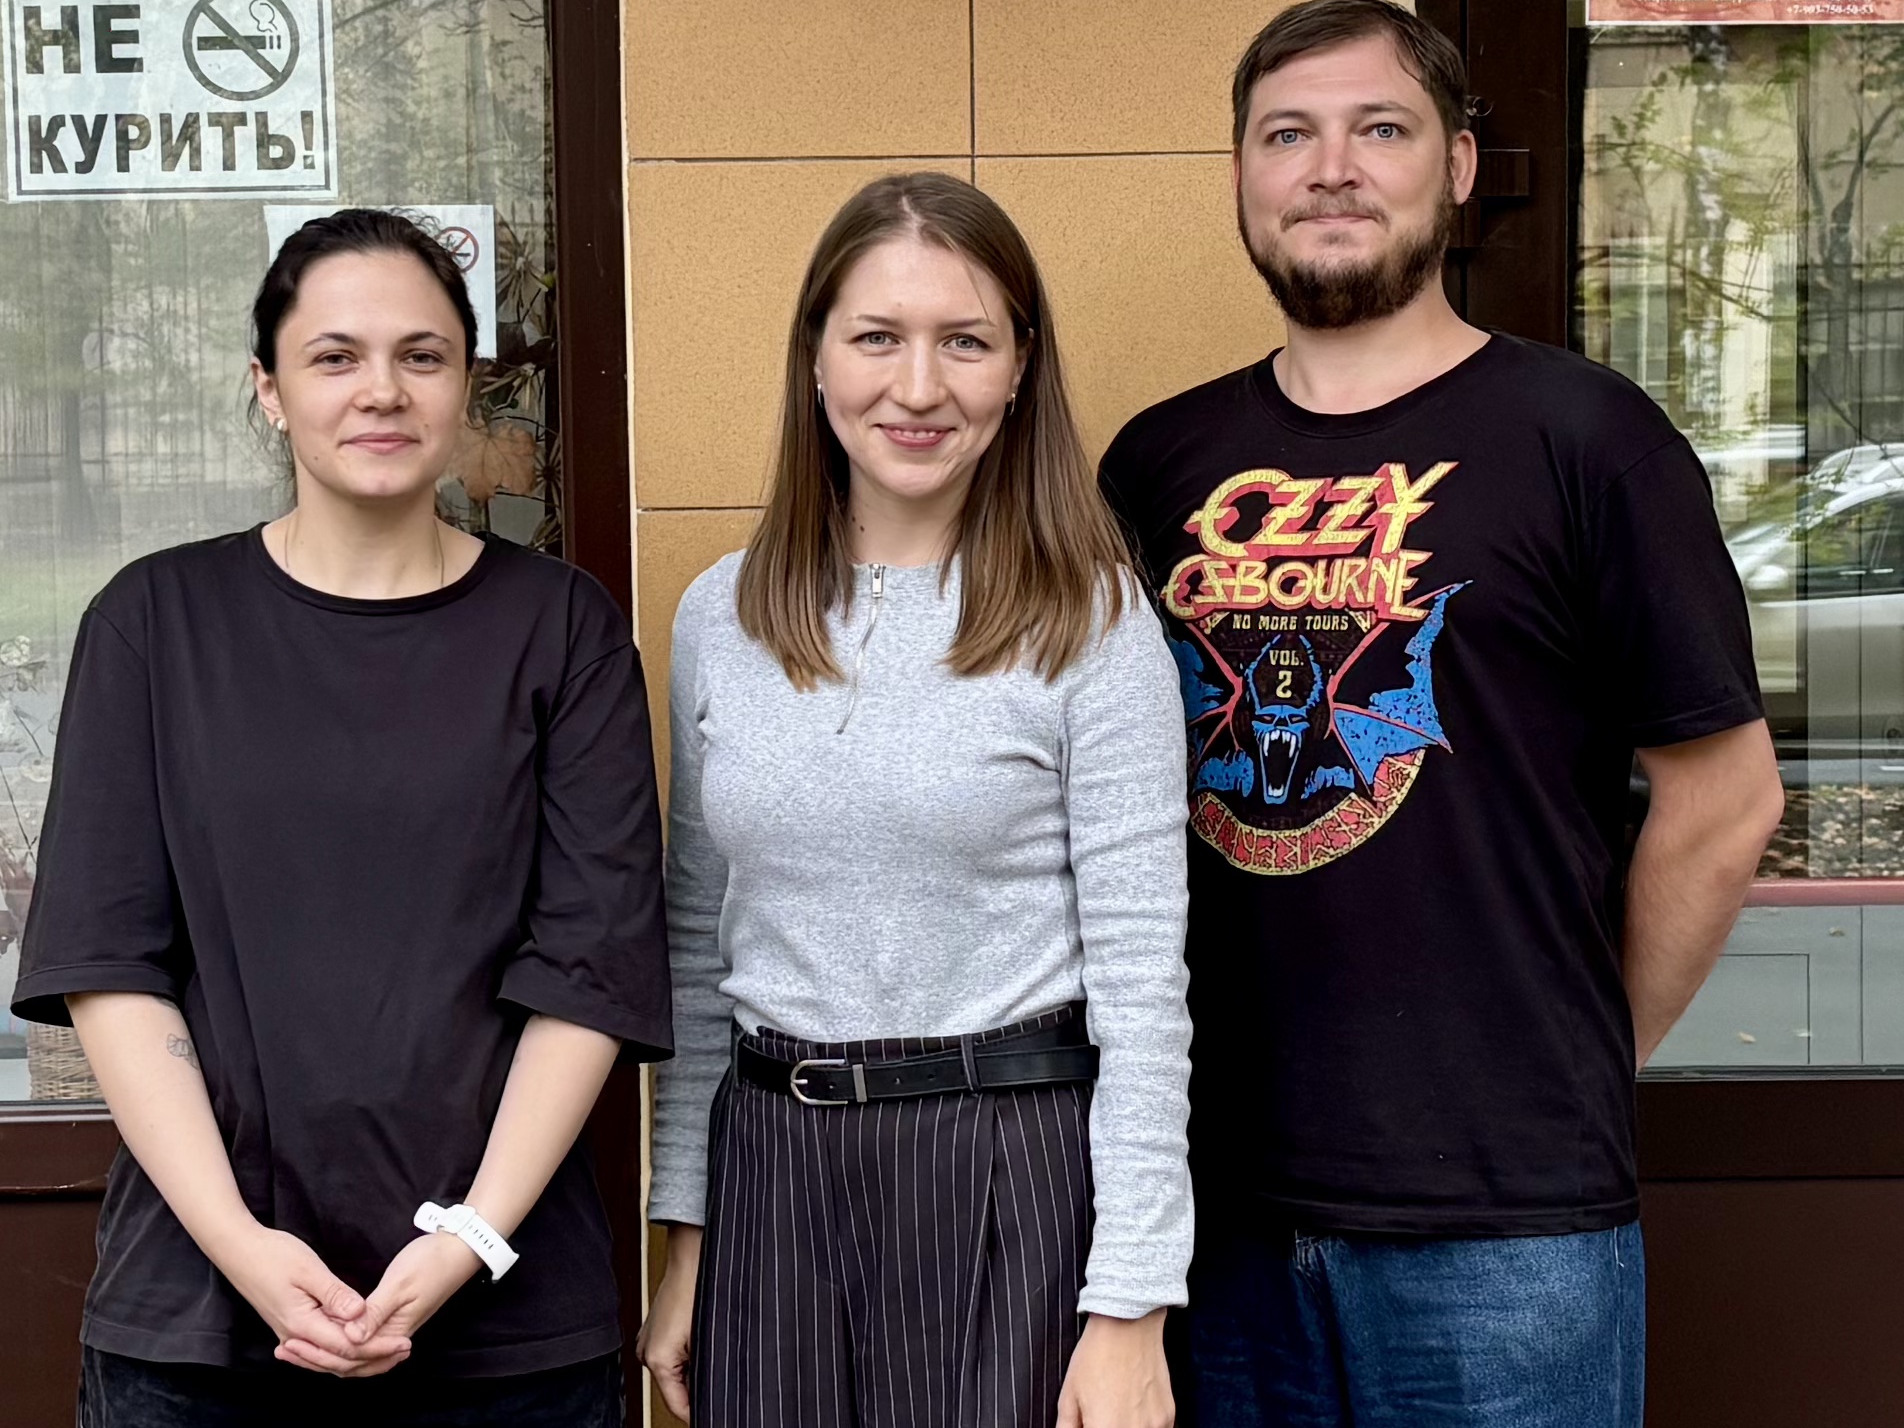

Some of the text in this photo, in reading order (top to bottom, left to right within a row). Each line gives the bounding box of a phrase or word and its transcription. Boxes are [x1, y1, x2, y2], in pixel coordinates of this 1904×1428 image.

[24, 5, 143, 74] НЕ
[29, 111, 316, 174] КУРИТЬ!
[1184, 461, 1459, 558] OZZY
[1161, 551, 1433, 620] OSBOURNE
[1232, 614, 1349, 631] NO MORE TOURS
[1275, 670, 1293, 699] 2
